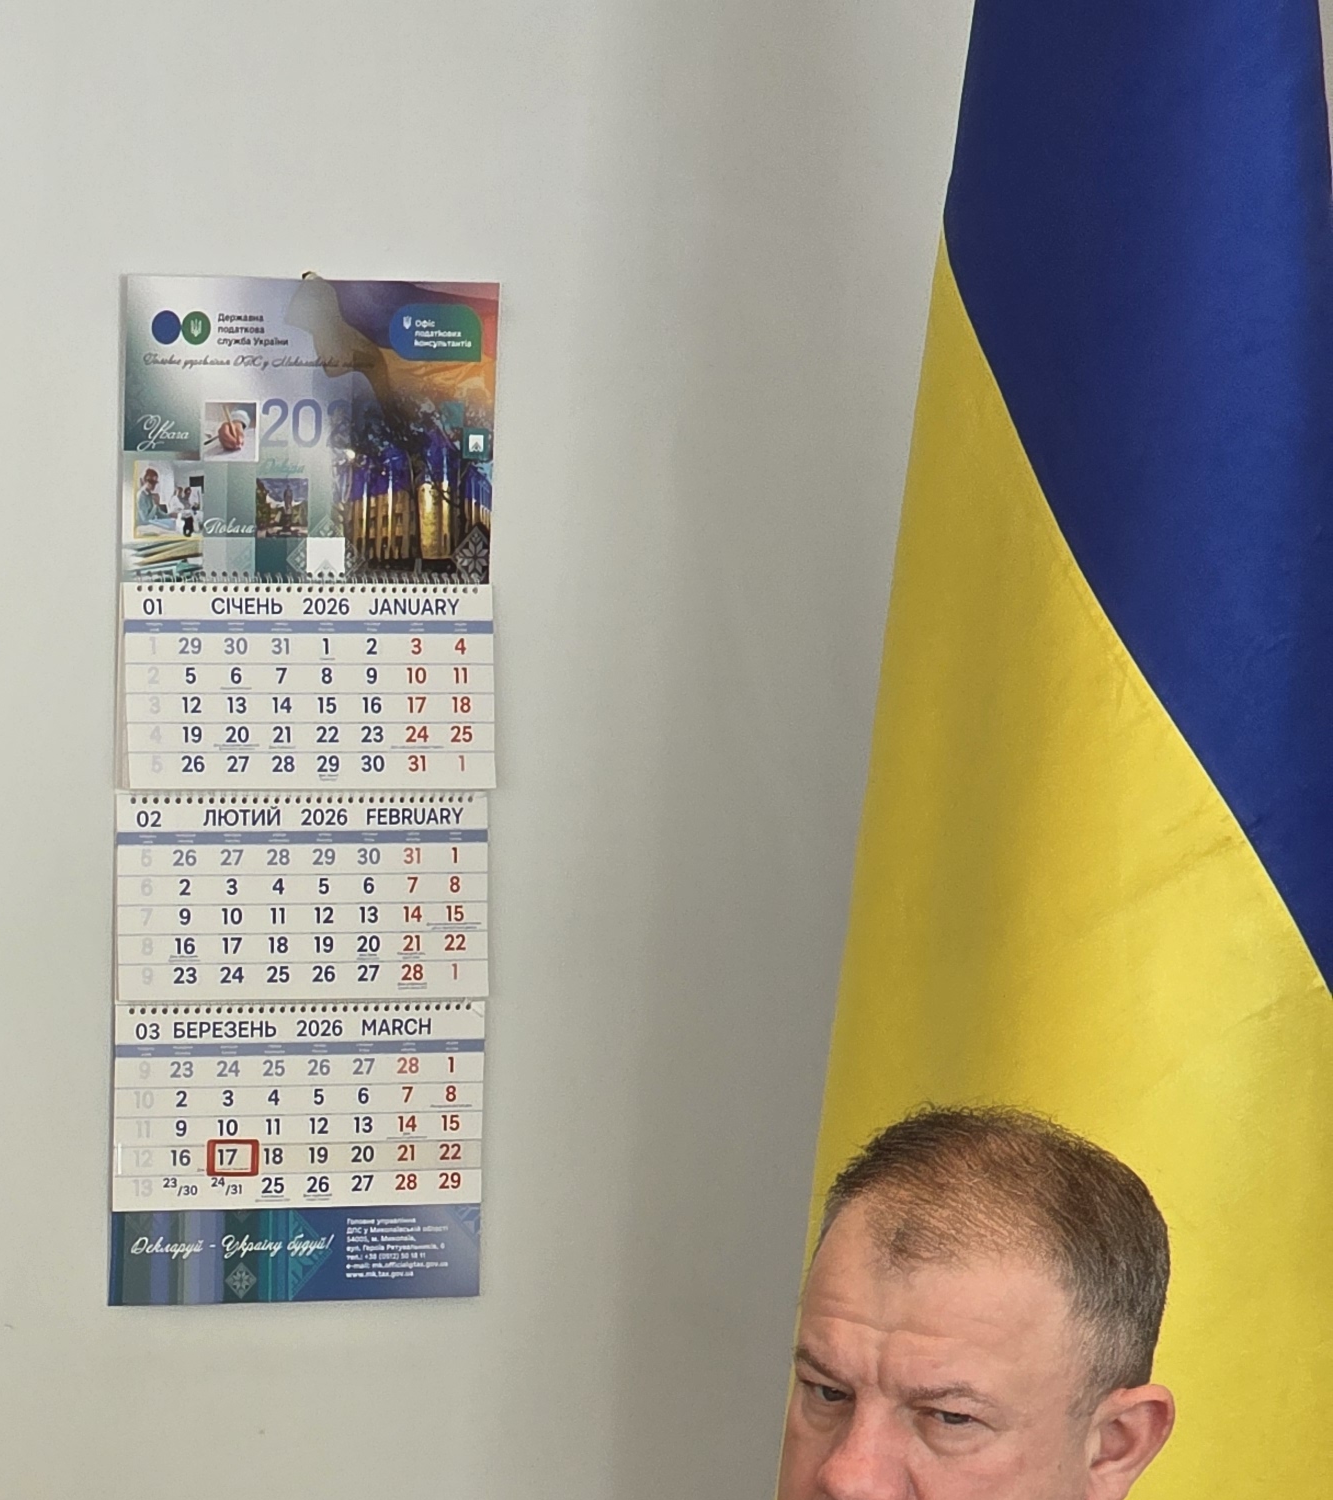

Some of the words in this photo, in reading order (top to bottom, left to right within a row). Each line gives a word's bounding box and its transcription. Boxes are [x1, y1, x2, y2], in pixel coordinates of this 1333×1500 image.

[142, 597, 163, 616] 01
[210, 596, 284, 616] СІЧЕНЬ
[302, 597, 350, 616] 2026
[368, 597, 460, 616] JANUARY
[181, 695, 203, 714] 12
[226, 696, 248, 715] 13
[271, 696, 293, 714] 14
[316, 696, 337, 715] 15
[361, 695, 382, 715] 16
[406, 695, 427, 714] 17
[451, 695, 472, 714] 18
[182, 725, 203, 744] 19
[225, 725, 250, 744] 20
[272, 725, 292, 744] 21
[315, 725, 340, 744] 22
[360, 725, 385, 744] 23
[405, 725, 430, 743] 24
[450, 725, 473, 743] 25
[136, 809, 162, 828] 02
[202, 805, 281, 827] ЛЮТИЙ
[300, 807, 348, 827] 2026
[366, 806, 465, 826] FEBRUARY
[174, 936, 196, 955] 16
[221, 936, 243, 955] 17
[267, 935, 289, 955] 18
[313, 935, 334, 954] 19
[356, 934, 381, 953] 20
[402, 934, 421, 952] 21
[444, 933, 467, 952] 22
[135, 1022, 161, 1041] 03
[173, 1019, 277, 1039] БЕРЕЗЕНЬ
[296, 1018, 344, 1038] 2026
[361, 1017, 432, 1037] MARCH
[170, 1148, 192, 1167] 16
[217, 1148, 239, 1167] 17
[263, 1147, 284, 1166] 18
[308, 1146, 329, 1165] 19
[350, 1145, 375, 1163] 20
[396, 1144, 415, 1162] 21
[438, 1142, 462, 1161] 22
